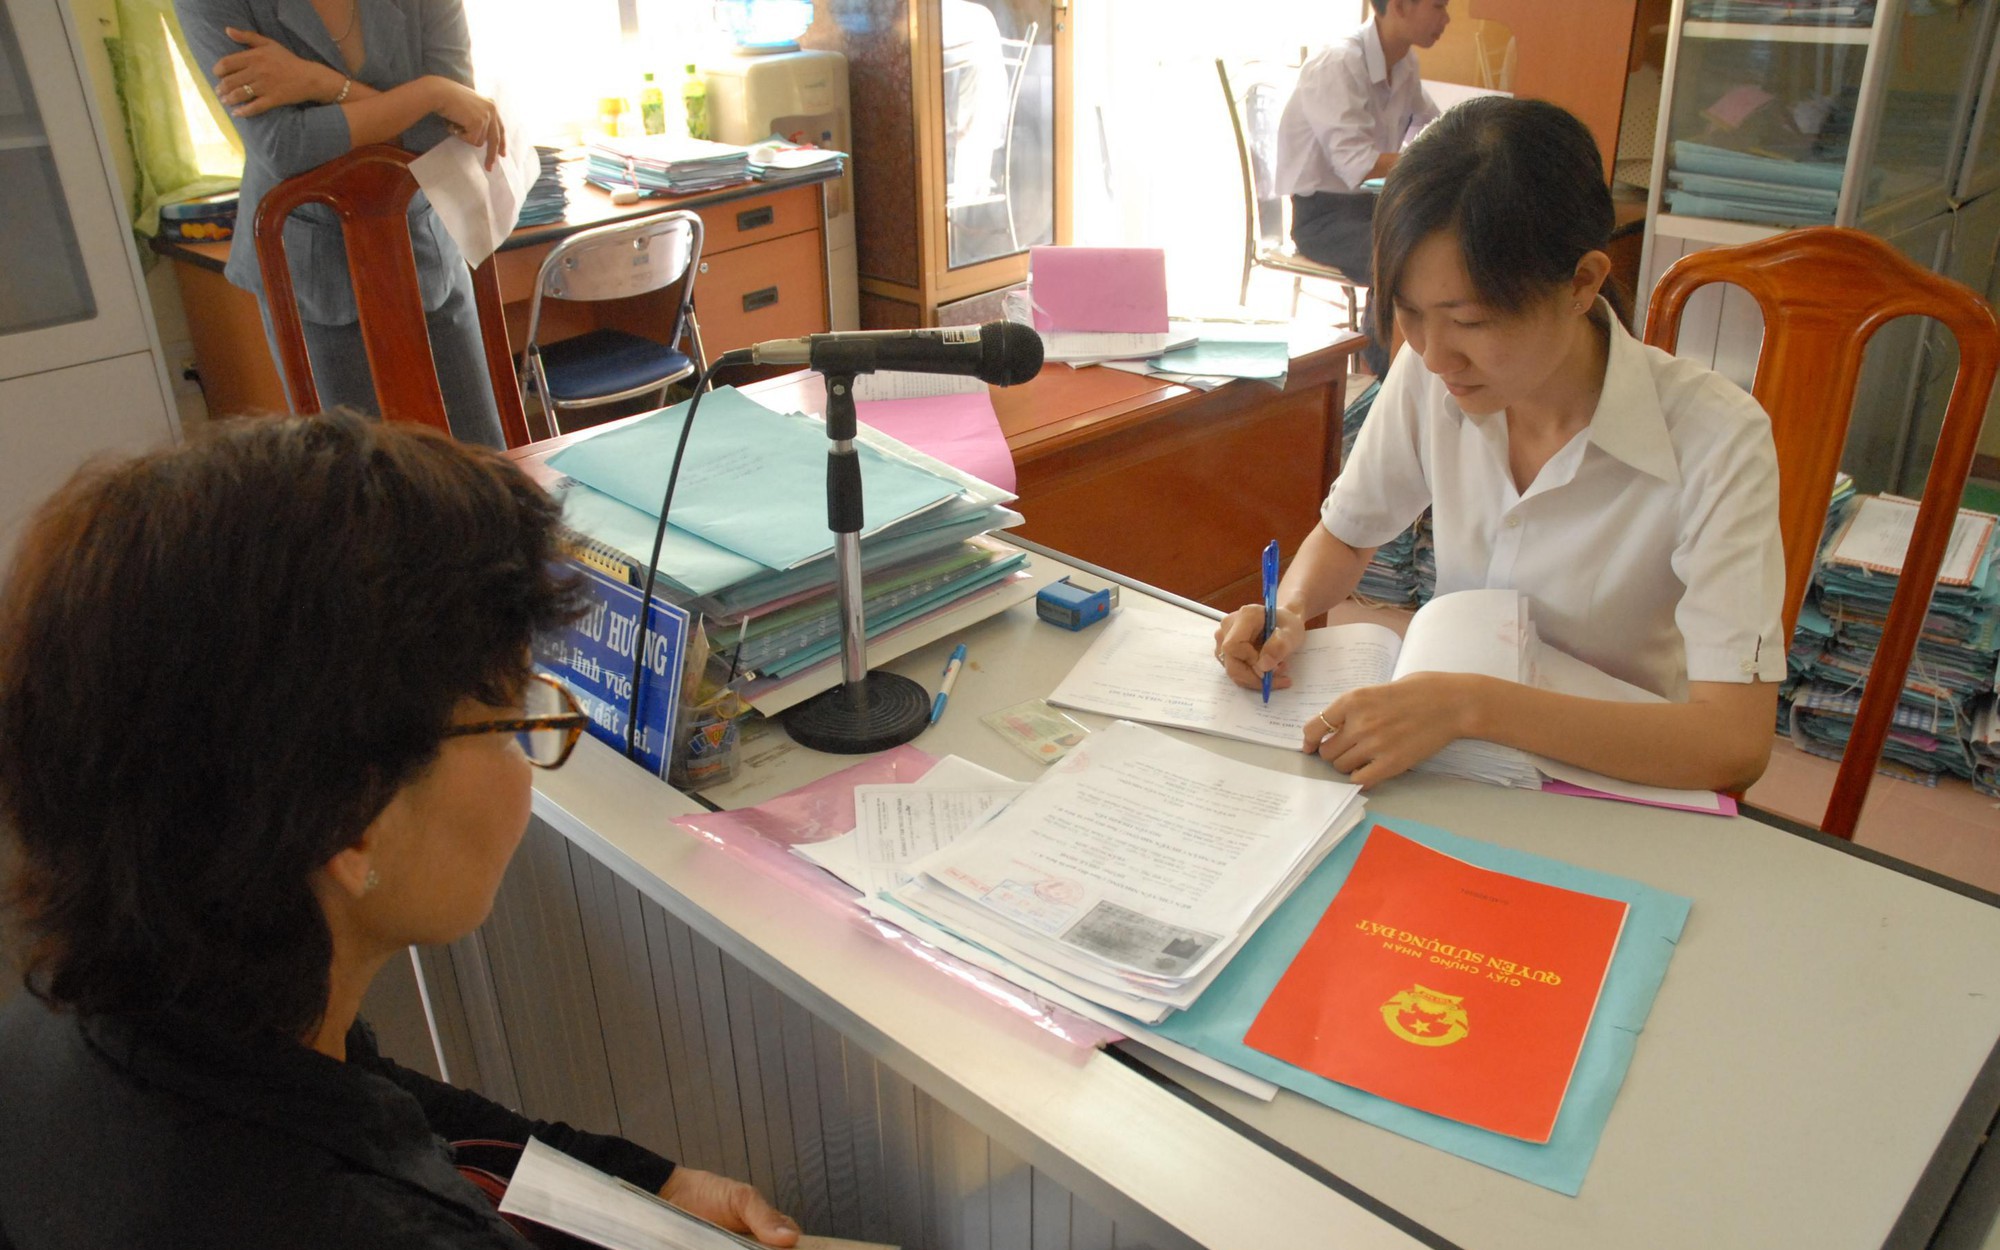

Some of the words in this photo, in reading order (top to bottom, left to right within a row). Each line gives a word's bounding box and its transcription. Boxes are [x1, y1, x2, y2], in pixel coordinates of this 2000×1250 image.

[576, 601, 608, 642] HƯ
[571, 647, 600, 683] lĩnh
[604, 670, 632, 700] vực
[594, 701, 620, 735] đất
[1355, 919, 1397, 939] ĐẤT
[1399, 931, 1458, 957] DỤNG
[1454, 948, 1485, 964] SỬ
[1430, 955, 1479, 974] CHỨNG
[1486, 957, 1562, 986] QUYỀN
[1486, 970, 1521, 987] GIẤY
